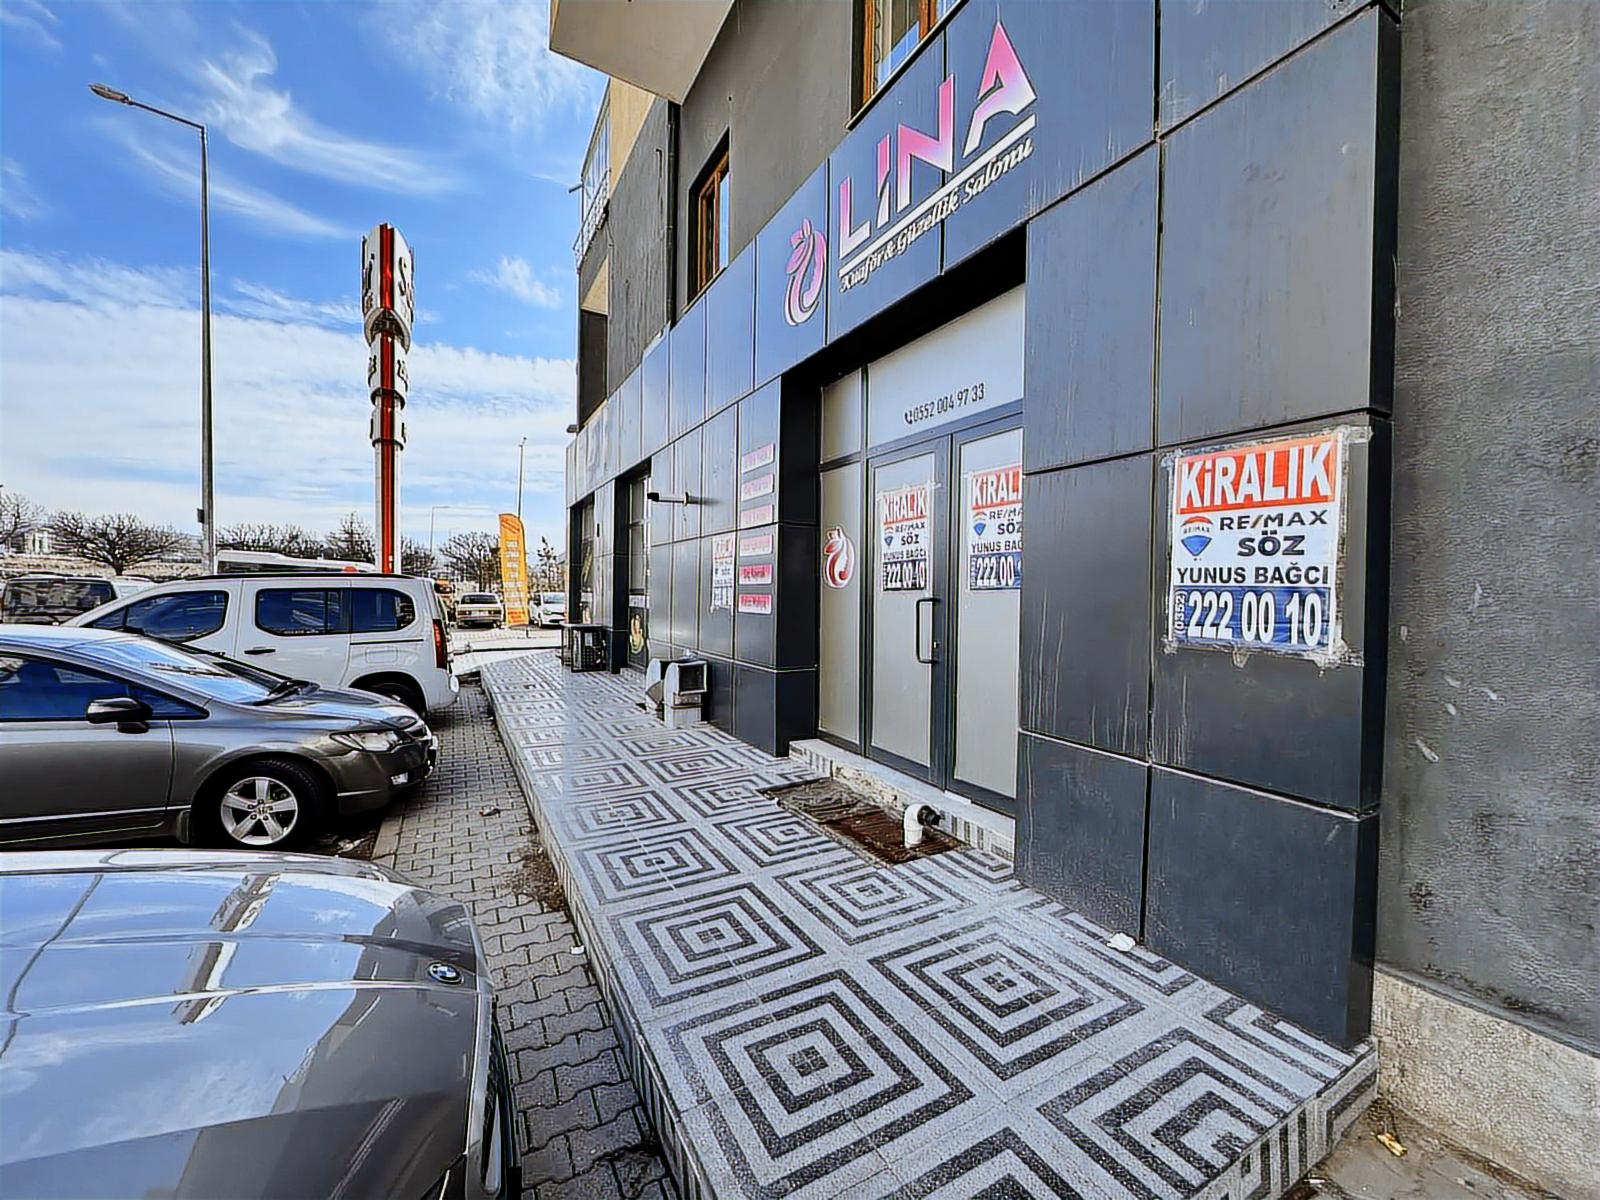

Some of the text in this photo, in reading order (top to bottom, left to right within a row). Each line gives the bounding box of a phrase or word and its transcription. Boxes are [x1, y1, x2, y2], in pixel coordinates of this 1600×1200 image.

[961, 137, 1034, 204] Salonu
[913, 382, 985, 423] 0552 004 97 33
[988, 507, 1024, 520] RE/MA
[1219, 509, 1329, 532] RE/MAX
[895, 521, 926, 534] RE/MAX
[900, 531, 920, 546] SÖZ
[971, 541, 1001, 554] YUNUS
[1237, 530, 1305, 557] SÖZ
[976, 556, 997, 586] 222
[999, 555, 1014, 587] 00
[1177, 562, 1329, 585] YUNUS BAĞCI
[1187, 589, 1234, 640] 222
[1241, 590, 1275, 644] 00
[1285, 592, 1322, 647] 10
